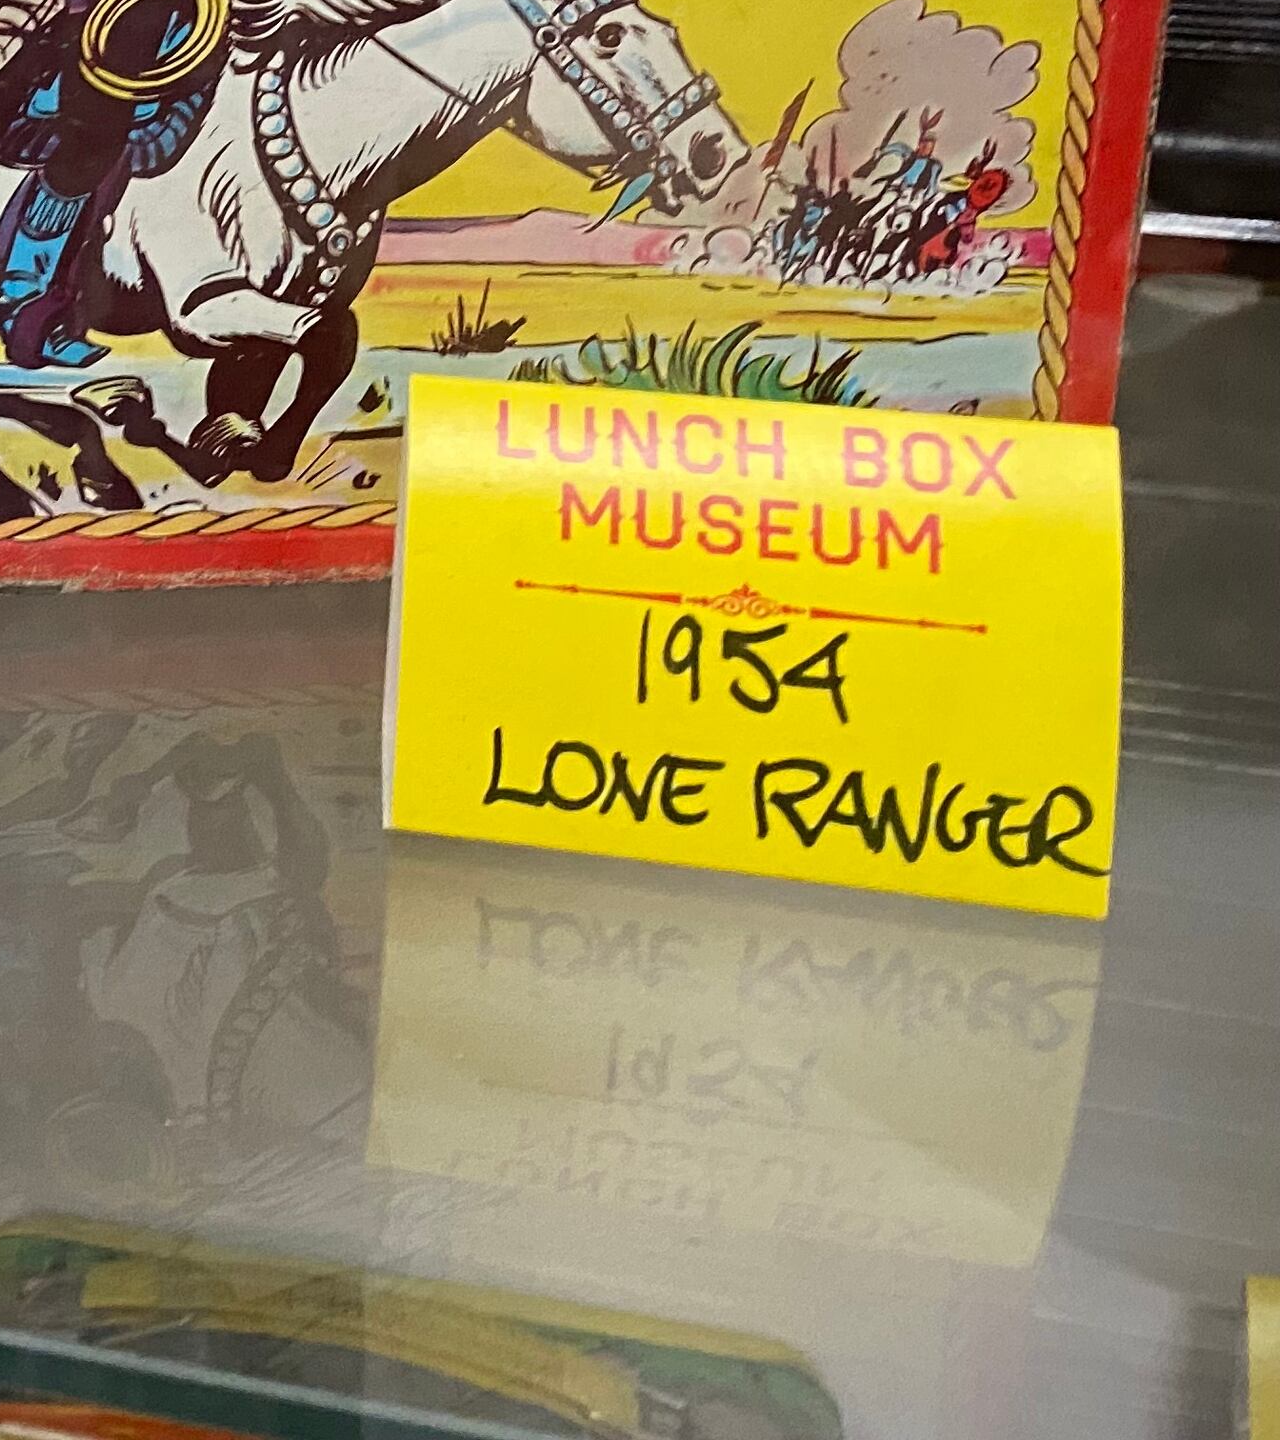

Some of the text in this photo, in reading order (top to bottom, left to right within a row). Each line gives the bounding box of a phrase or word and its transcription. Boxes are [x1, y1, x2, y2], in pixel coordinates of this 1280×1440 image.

[496, 400, 1018, 501] LUNCH BOX
[557, 480, 945, 575] MUSEUM
[636, 607, 850, 724] 1954
[483, 725, 1112, 878] LONE RANGER
